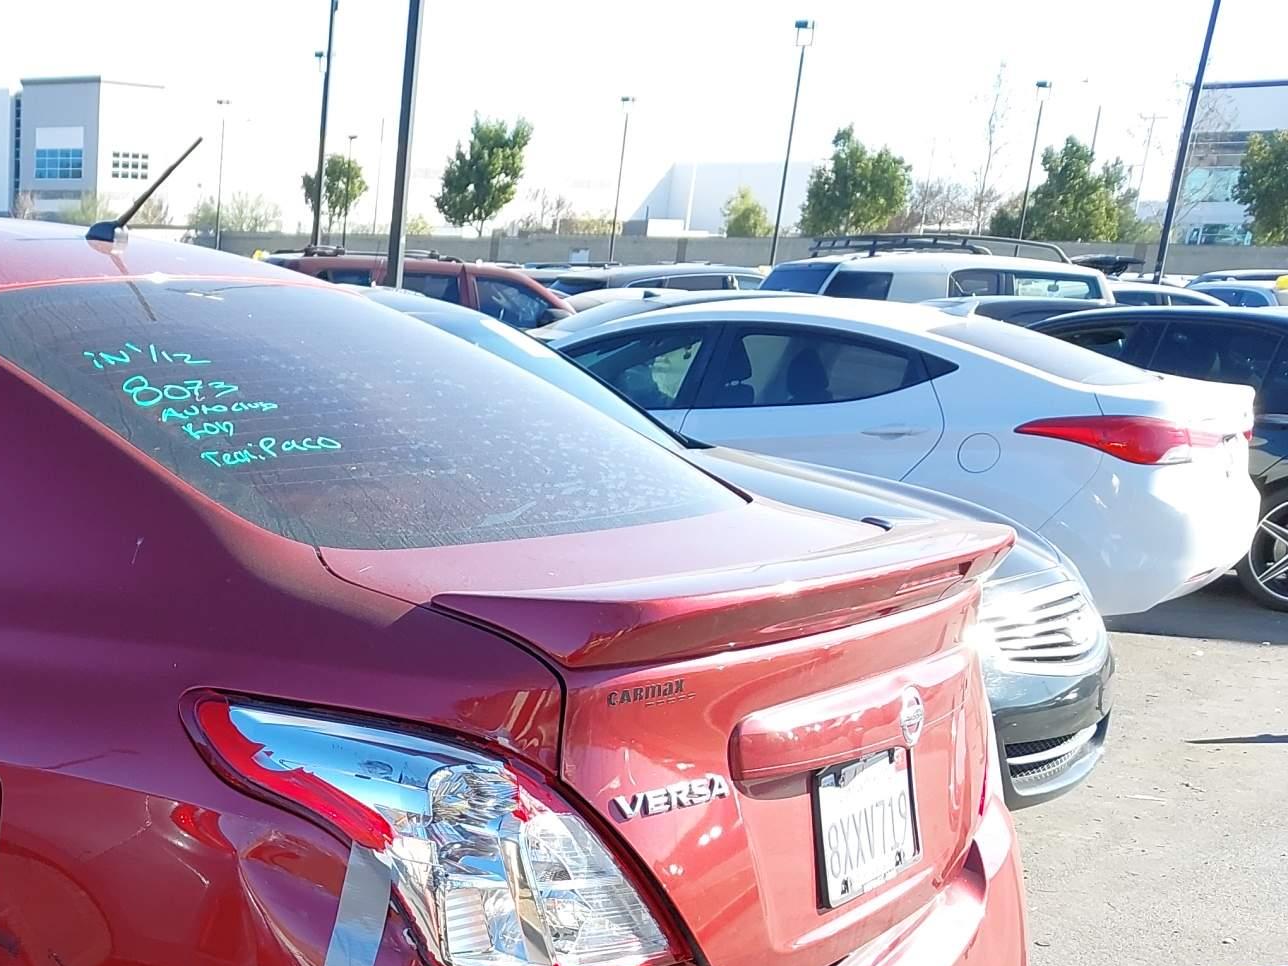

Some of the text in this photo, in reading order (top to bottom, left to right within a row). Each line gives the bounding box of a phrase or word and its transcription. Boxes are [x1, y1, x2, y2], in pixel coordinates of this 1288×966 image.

[122, 376, 239, 407] 8073
[608, 772, 730, 823] VERSA
[827, 789, 909, 880] 8XXV719
